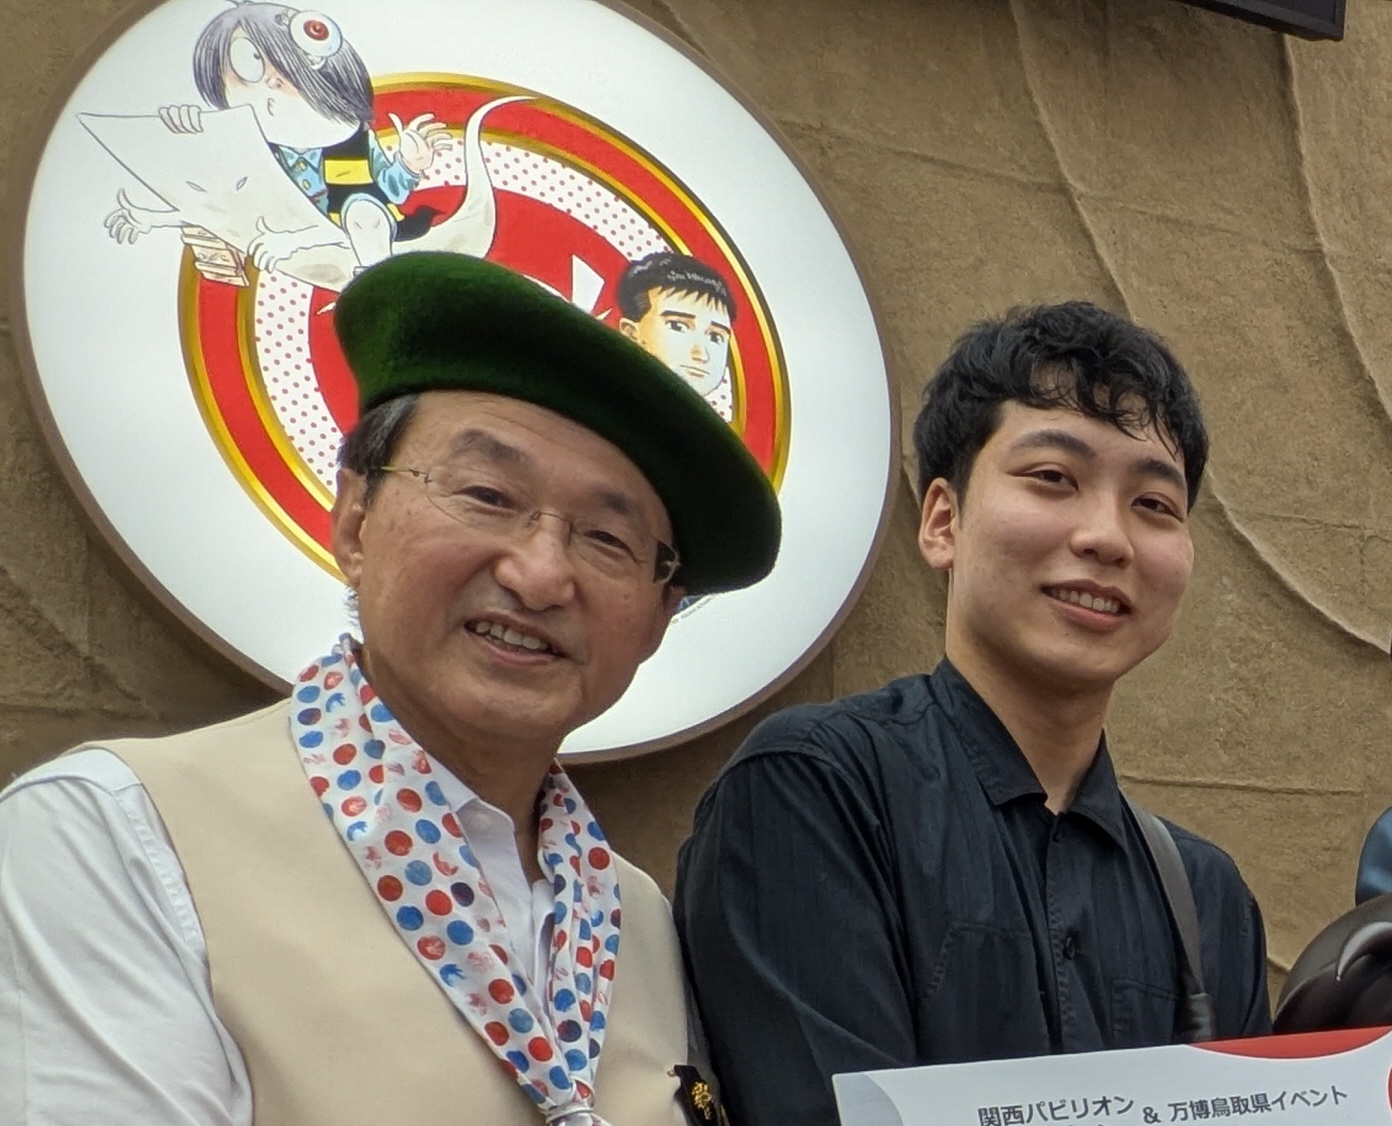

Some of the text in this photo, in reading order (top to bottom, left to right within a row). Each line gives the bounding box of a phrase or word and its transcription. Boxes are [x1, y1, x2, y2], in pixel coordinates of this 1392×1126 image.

[1143, 1106, 1161, 1124] &
[1169, 1085, 1349, 1123] 万博鳥取県イベント
